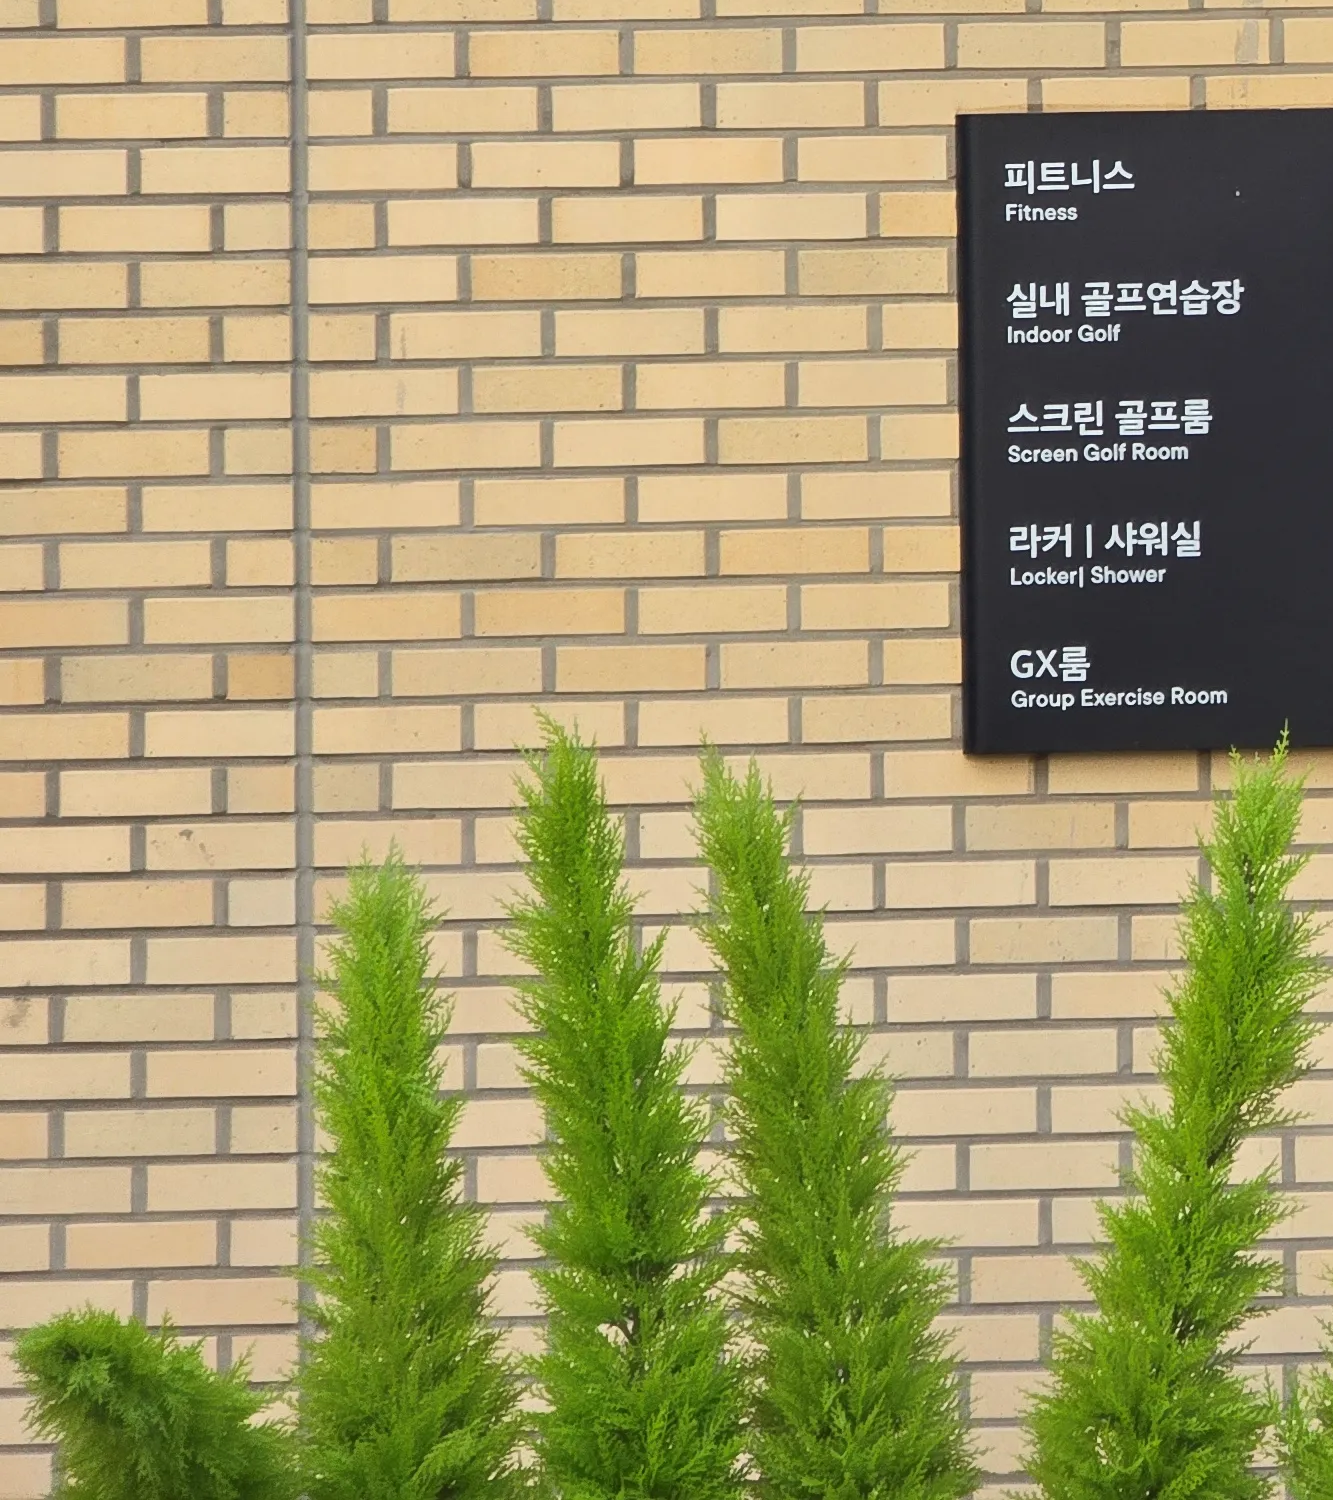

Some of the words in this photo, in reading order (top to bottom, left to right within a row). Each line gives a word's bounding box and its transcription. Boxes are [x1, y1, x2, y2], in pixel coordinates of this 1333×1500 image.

[1004, 158, 1136, 195] 피트니스
[1005, 203, 1079, 222] Fitness
[1006, 281, 1070, 319] 실내
[1080, 278, 1246, 318] 골프연습장
[1007, 325, 1073, 344] Indoor
[1077, 323, 1122, 343] Golf
[1006, 399, 1105, 437] 스크린
[1114, 398, 1214, 436] 골프룸
[1007, 444, 1079, 463] Screen
[1083, 442, 1127, 462] Golf
[1131, 442, 1189, 461] Room
[1009, 522, 1072, 559] 라커
[1104, 519, 1202, 558] 샤워실
[1090, 565, 1167, 584] Shower
[1010, 645, 1091, 682] GX룸
[1010, 689, 1076, 711] Group
[1080, 687, 1166, 707] Exercise
[1170, 686, 1228, 705] Room
